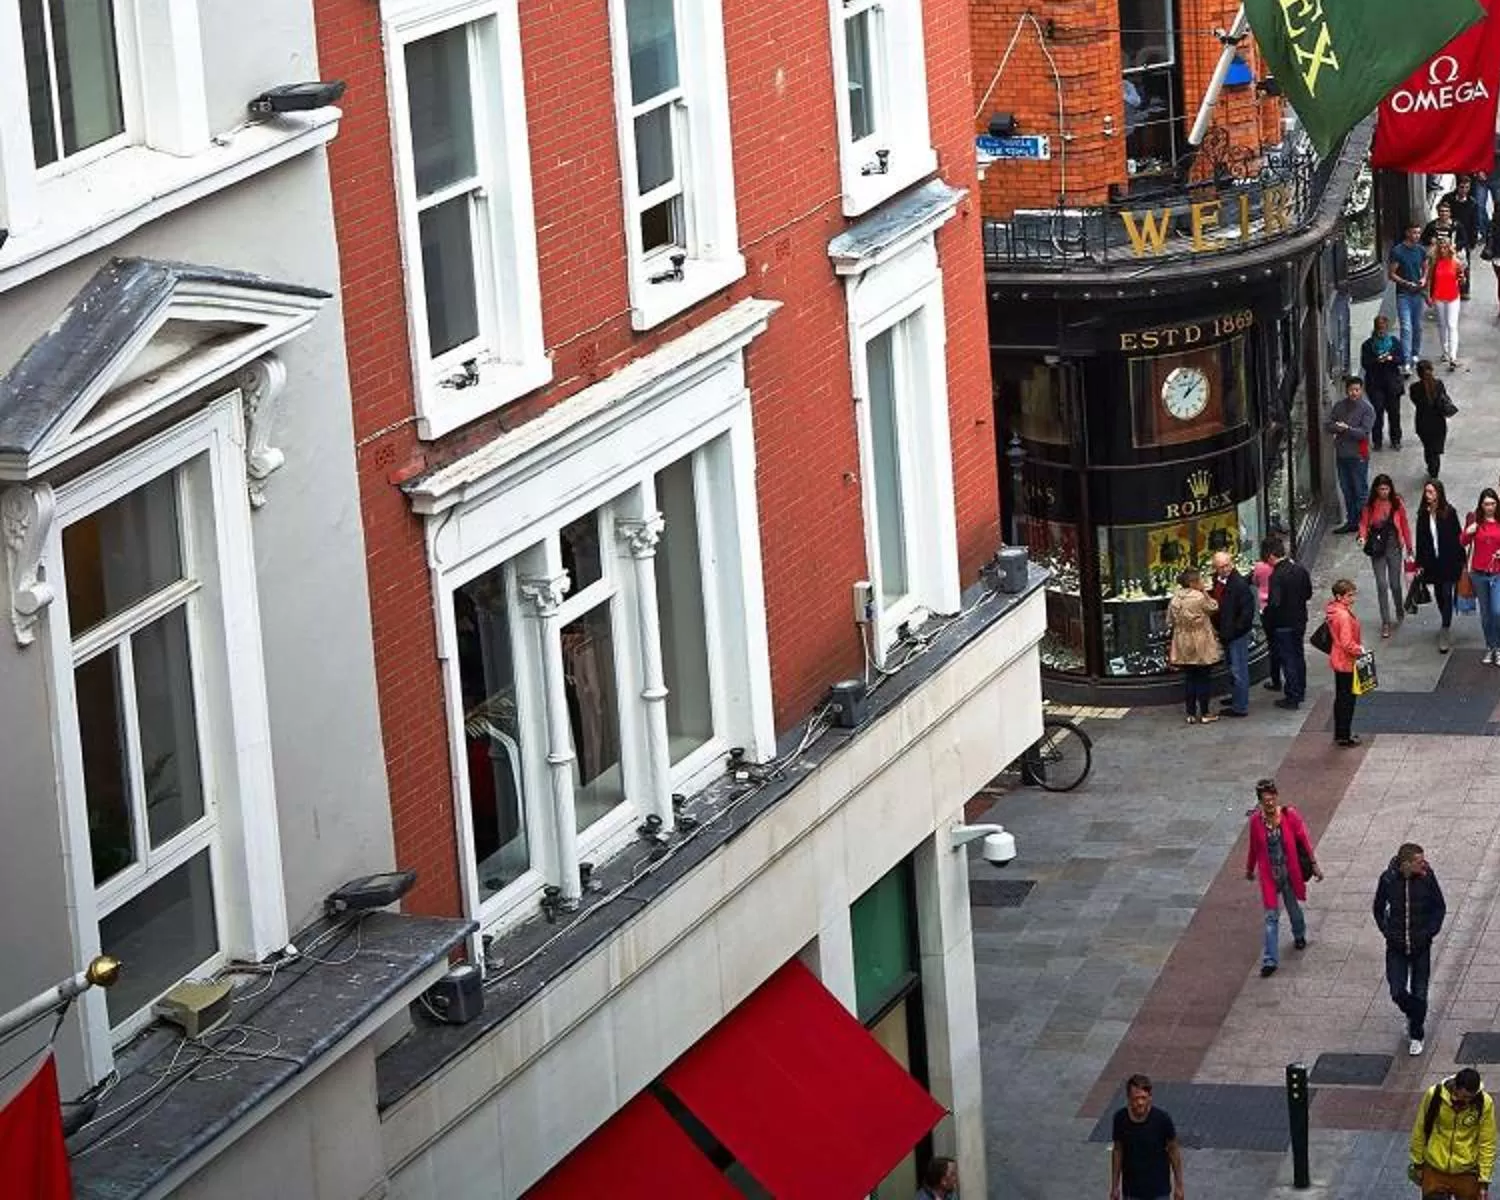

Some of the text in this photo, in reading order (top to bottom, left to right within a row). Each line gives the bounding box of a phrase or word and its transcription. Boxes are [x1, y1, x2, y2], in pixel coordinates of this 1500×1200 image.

[1391, 79, 1489, 113] OMEGA
[1119, 309, 1254, 351] ESTD 1869
[1165, 489, 1232, 519] ROLEX
